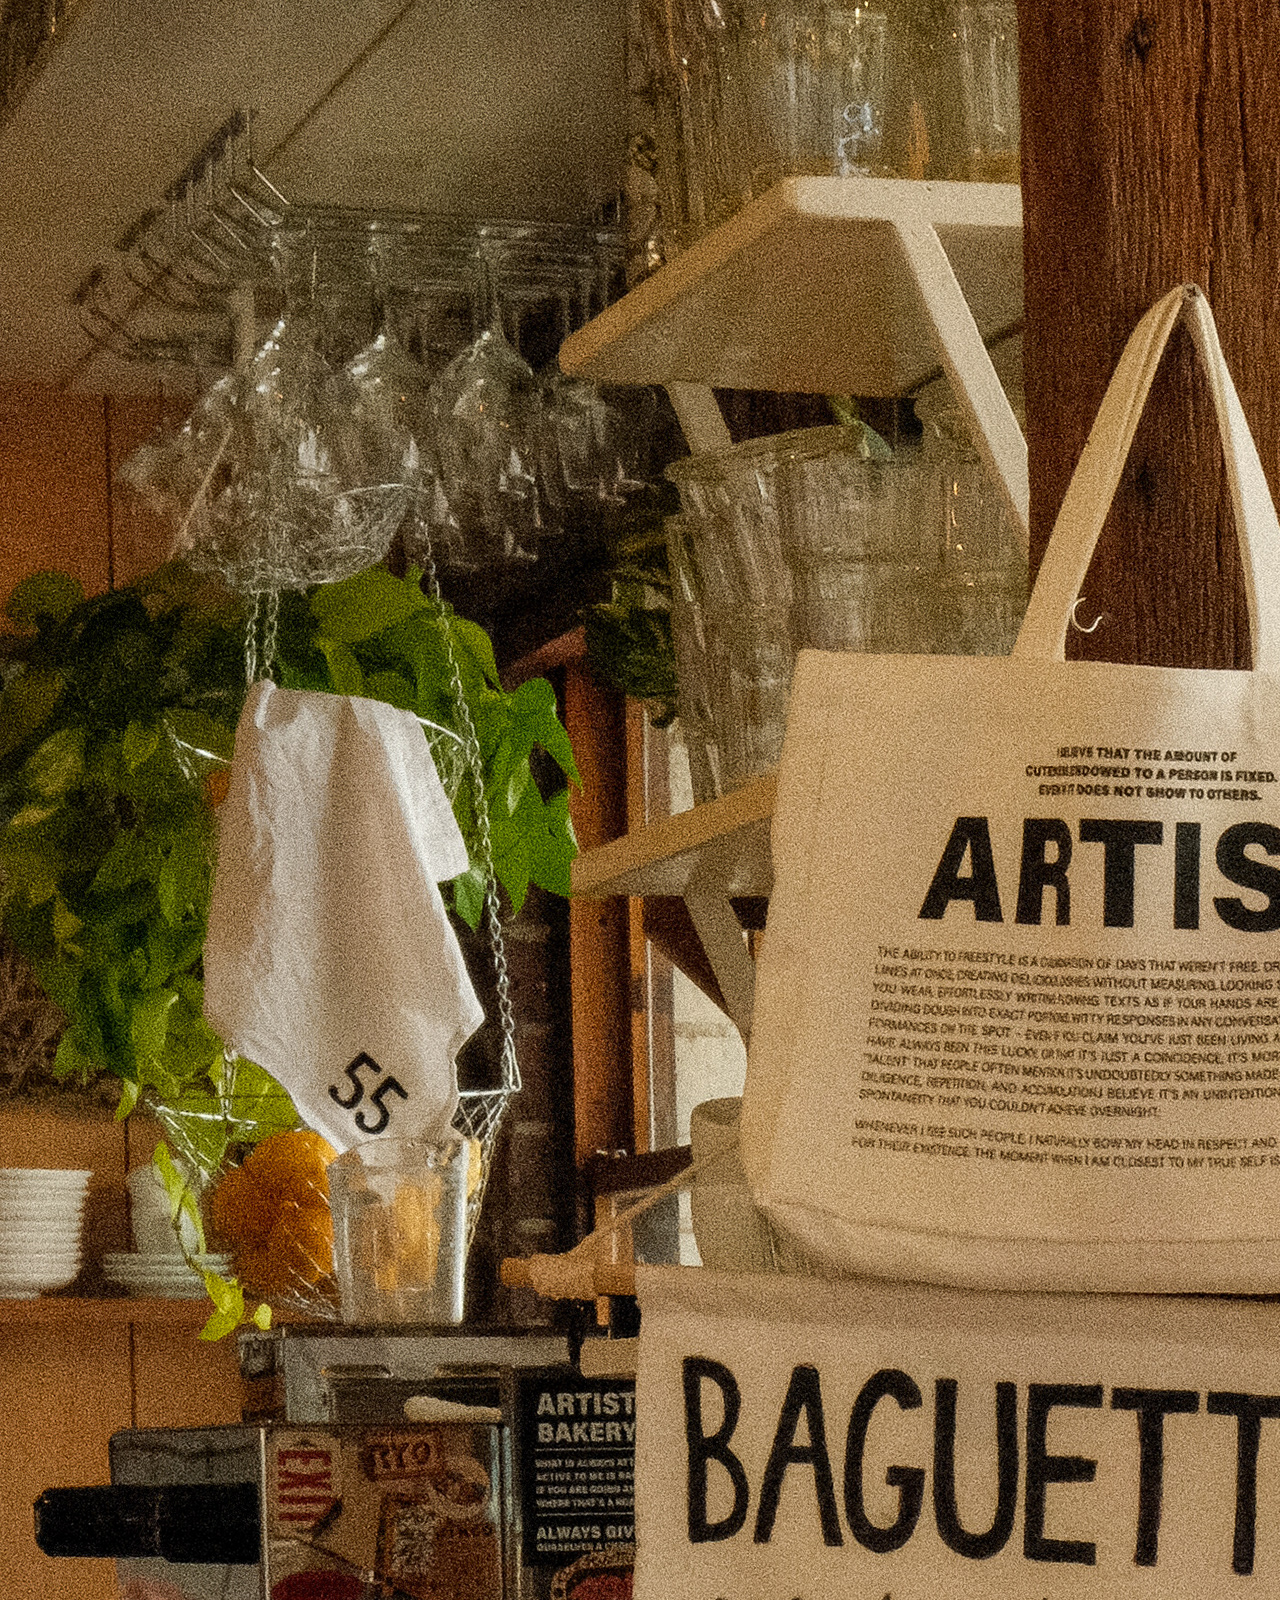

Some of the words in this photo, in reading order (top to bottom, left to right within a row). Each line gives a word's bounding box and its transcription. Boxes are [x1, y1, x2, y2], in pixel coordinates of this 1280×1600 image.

[1097, 747, 1130, 759] THAT
[1134, 748, 1161, 760] THE
[1164, 750, 1218, 762] AMOUNT
[1220, 751, 1238, 763] OF
[1134, 768, 1153, 779] TO
[1169, 770, 1218, 781] PERSON
[1236, 771, 1278, 783] FIXED.
[1077, 784, 1109, 796] DOES
[1113, 785, 1142, 797] NOT
[1147, 787, 1187, 799] SHOW
[1207, 788, 1262, 800] OTHERS.
[1149, 960, 1177, 971] THAT
[1220, 978, 1272, 991] LOOKING
[1210, 997, 1251, 1009] HANDS
[1174, 1069, 1242, 1083] SOMETHING
[1245, 1068, 1279, 1081] MADE
[328, 1050, 408, 1136] 55
[1197, 1138, 1248, 1150] RESPECT
[1252, 1136, 1277, 1148] AND
[537, 1392, 635, 1416] ARTIST
[538, 1422, 635, 1443] BAKERY
[536, 1526, 601, 1540] ALWAYS
